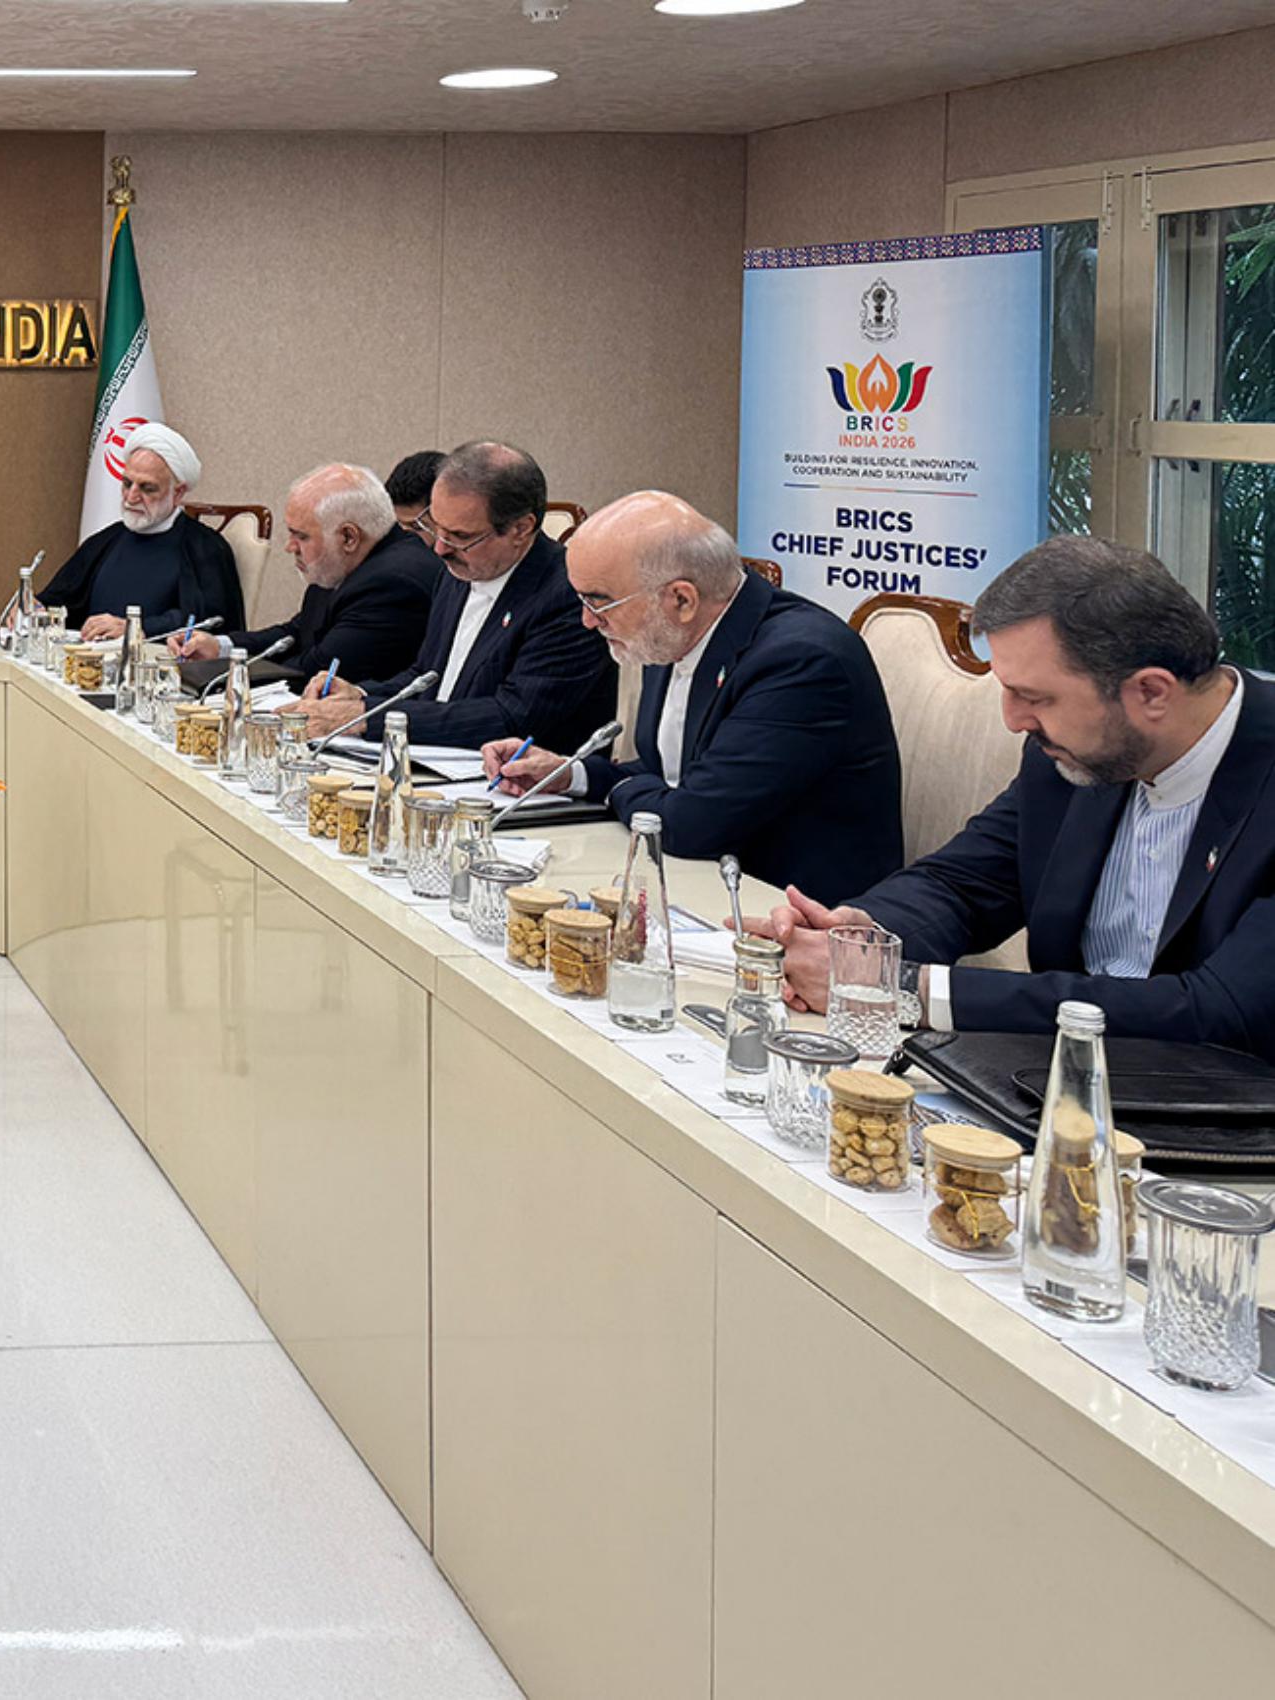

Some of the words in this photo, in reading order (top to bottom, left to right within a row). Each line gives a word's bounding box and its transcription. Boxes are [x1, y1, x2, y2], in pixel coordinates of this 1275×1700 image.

[846, 415, 908, 432] BRICS
[838, 435, 877, 448] INDIA
[882, 436, 916, 449] 2026
[784, 453, 827, 464] BUILDING
[829, 455, 848, 465] FOR
[851, 456, 908, 468] RESILIENCE,
[910, 458, 979, 471] INNOVATION,
[792, 465, 860, 478] COOPERATION
[861, 468, 883, 479] AND
[885, 470, 968, 483] SUSTAINABILITY
[835, 507, 914, 533] BRICS
[771, 532, 844, 557] CHIEF
[850, 541, 987, 570] JUSTICES'
[827, 566, 922, 595] FORUM
